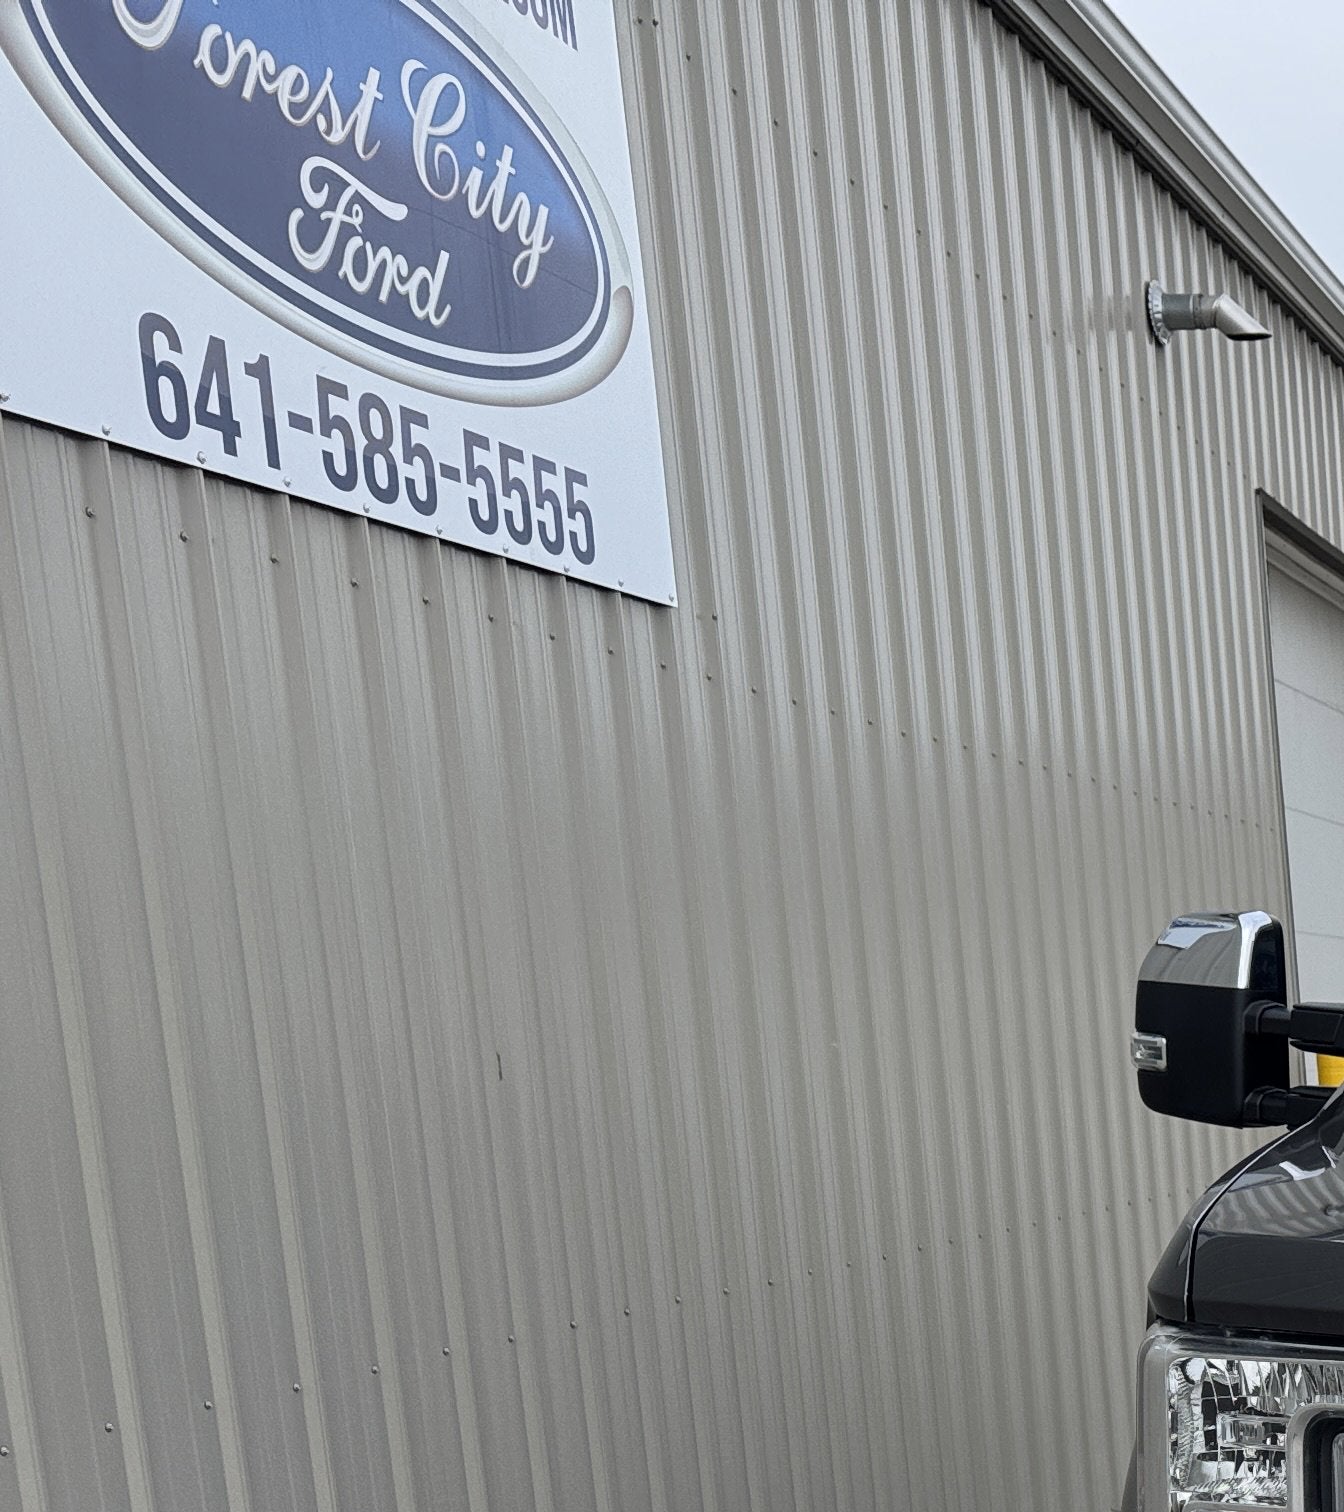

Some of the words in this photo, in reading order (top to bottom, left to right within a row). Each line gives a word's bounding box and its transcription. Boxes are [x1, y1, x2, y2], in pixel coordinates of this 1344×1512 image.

[288, 156, 451, 327] Ford
[400, 58, 554, 288] City
[138, 312, 595, 565] 641-585-5555
